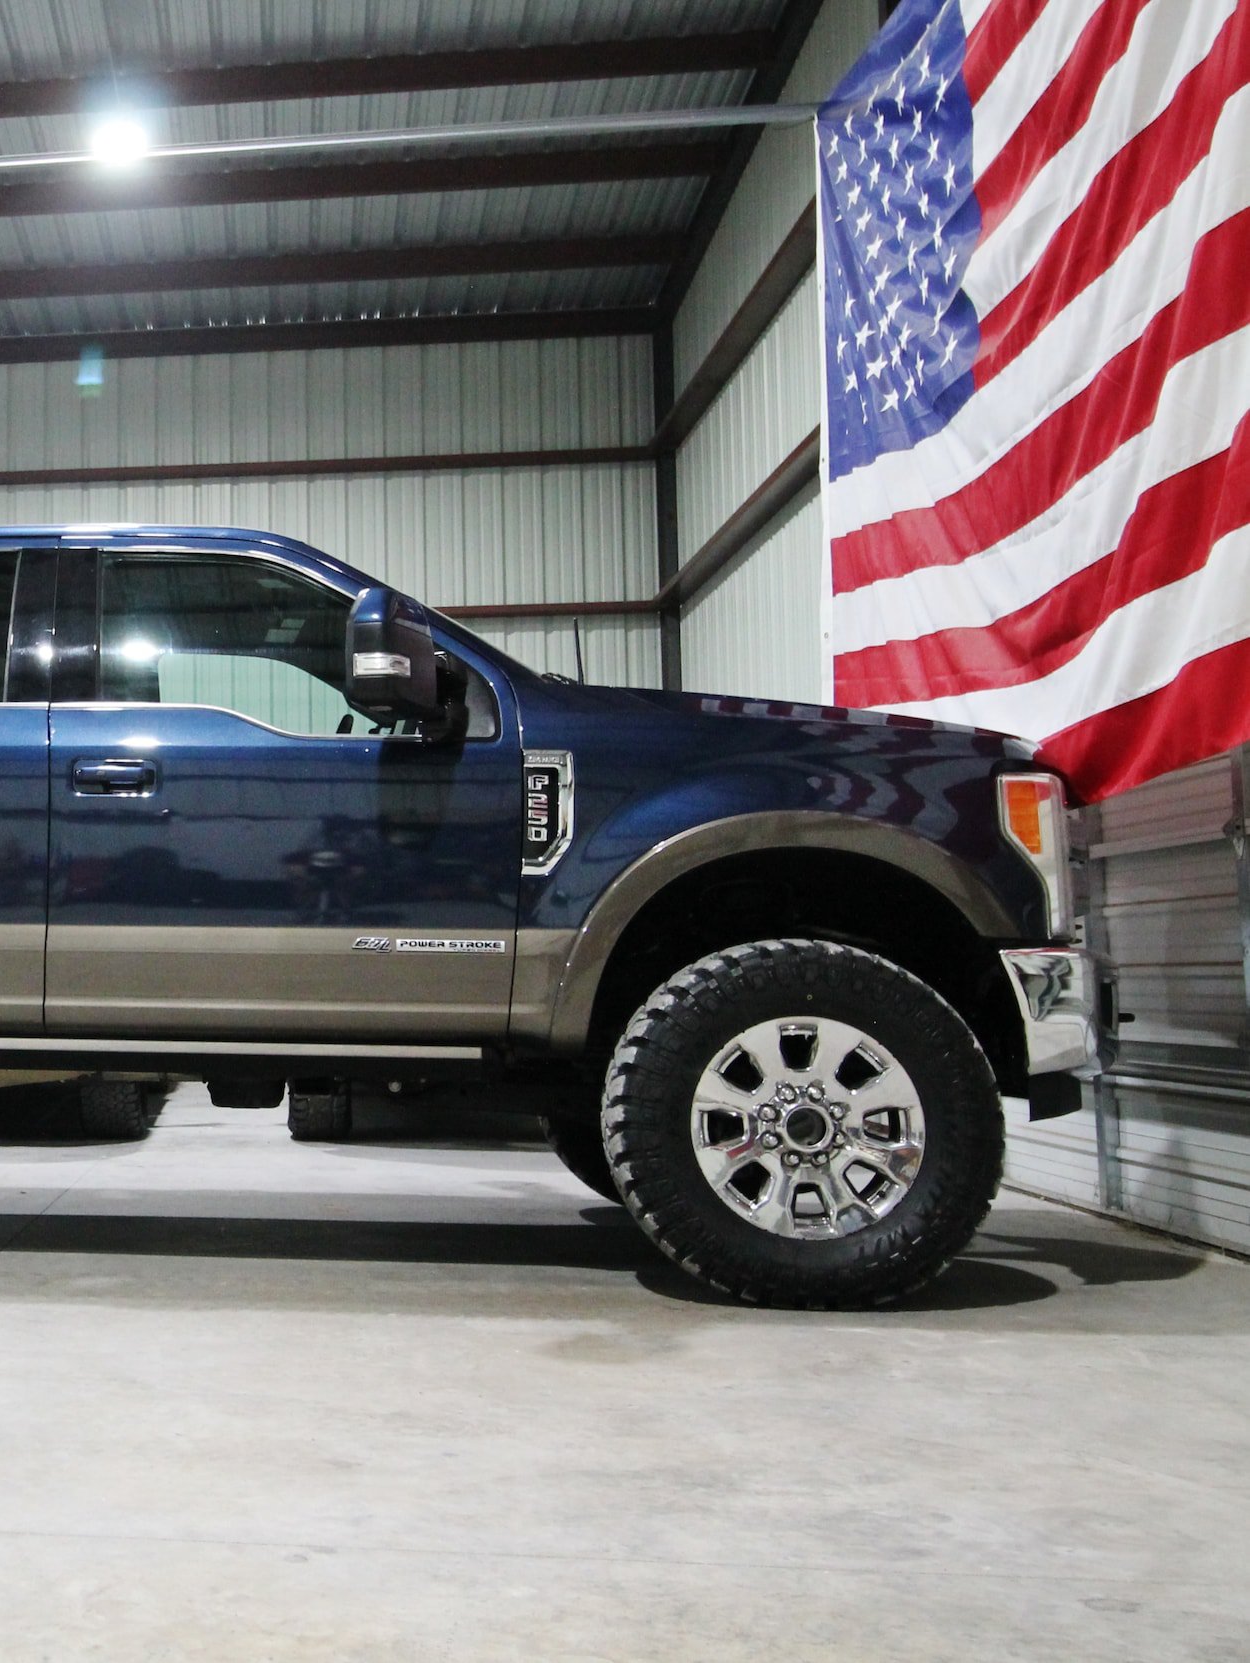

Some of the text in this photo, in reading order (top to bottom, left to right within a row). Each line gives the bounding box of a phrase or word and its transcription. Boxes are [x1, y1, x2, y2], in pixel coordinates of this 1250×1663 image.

[527, 774, 549, 842] F250
[399, 940, 501, 949] POWER STROKE
